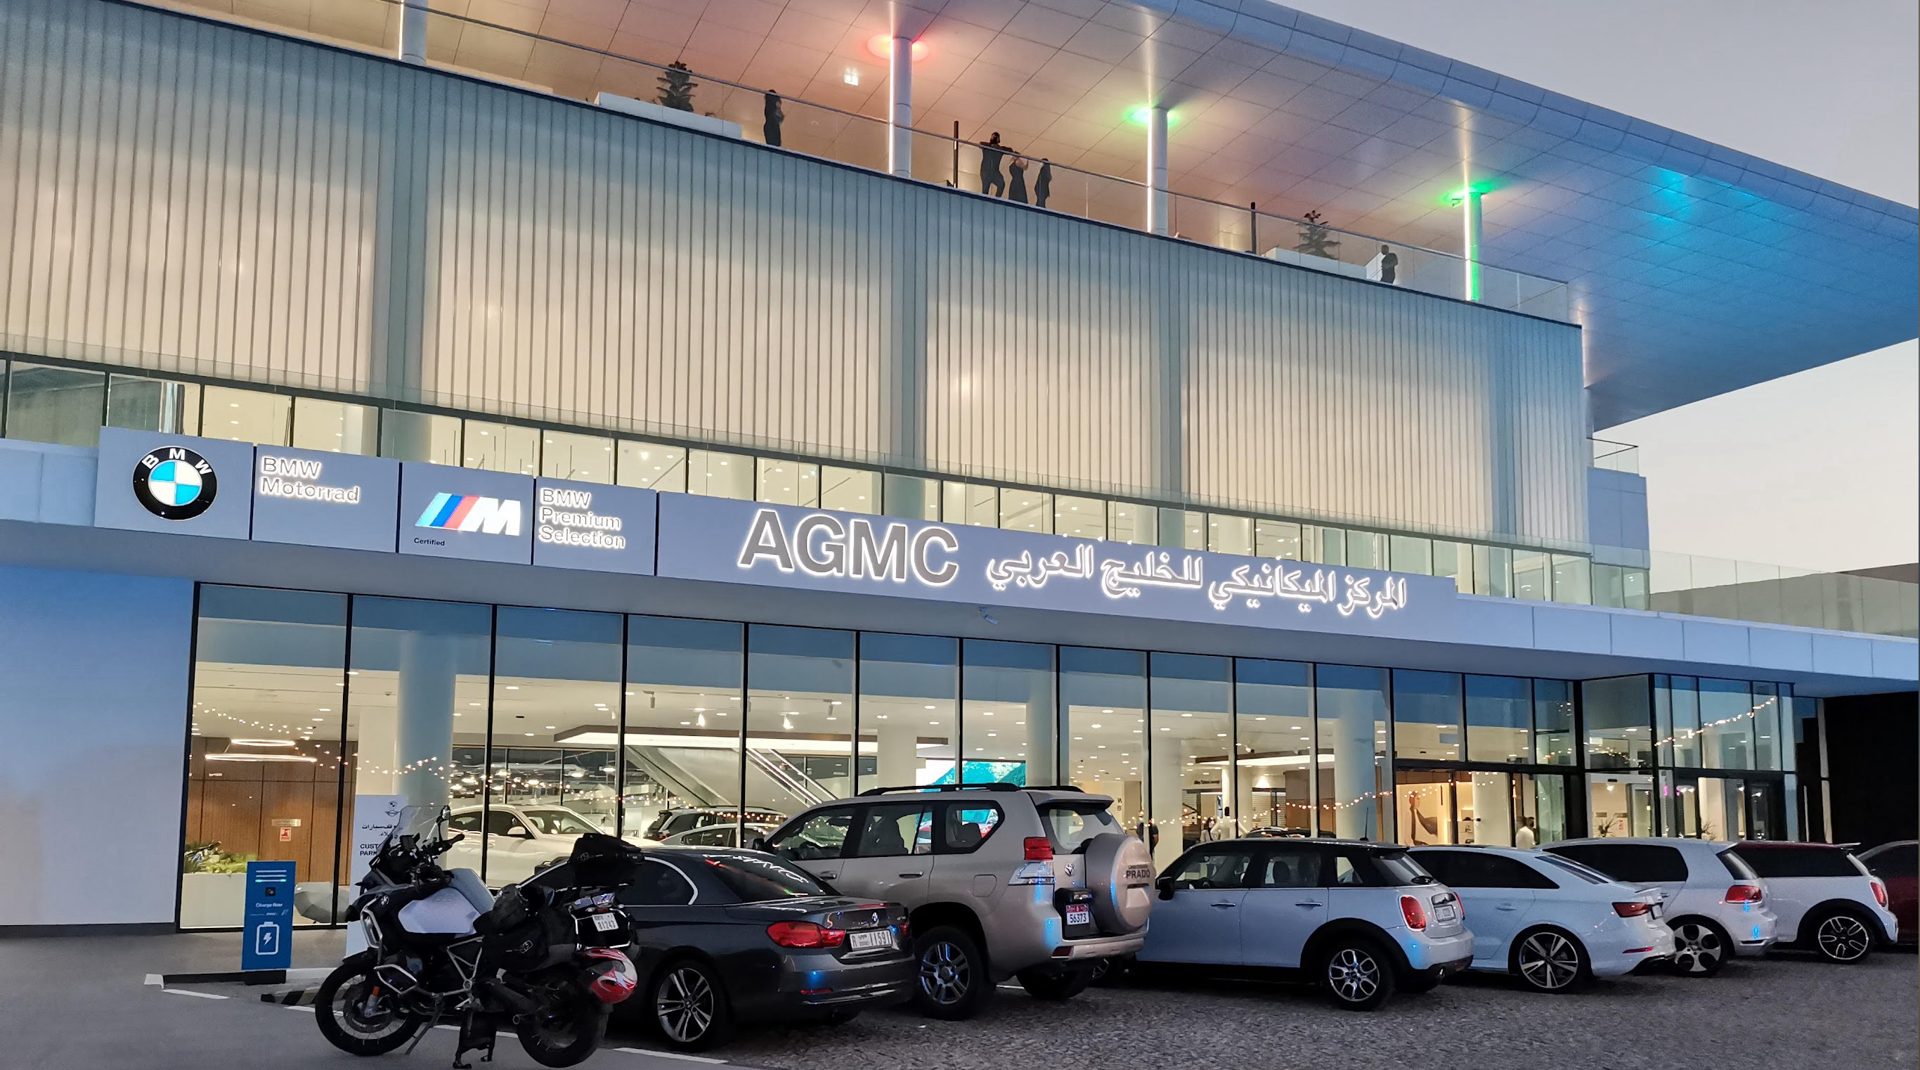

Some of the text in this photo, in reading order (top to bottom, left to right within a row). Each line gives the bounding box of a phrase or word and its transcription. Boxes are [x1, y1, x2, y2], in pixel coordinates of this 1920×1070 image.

[142, 448, 213, 476] BMW
[262, 456, 322, 479] BMW
[261, 478, 360, 503] Motorrad
[541, 488, 592, 509] BMW
[540, 507, 621, 530] Premium
[413, 537, 446, 547] Certified
[539, 526, 625, 549] Selection
[738, 509, 959, 587] AGMC
[987, 543, 1407, 618] المركز الميكانيكي للخليج العربي
[1126, 869, 1151, 879] PRADO
[1069, 912, 1087, 923] 56373
